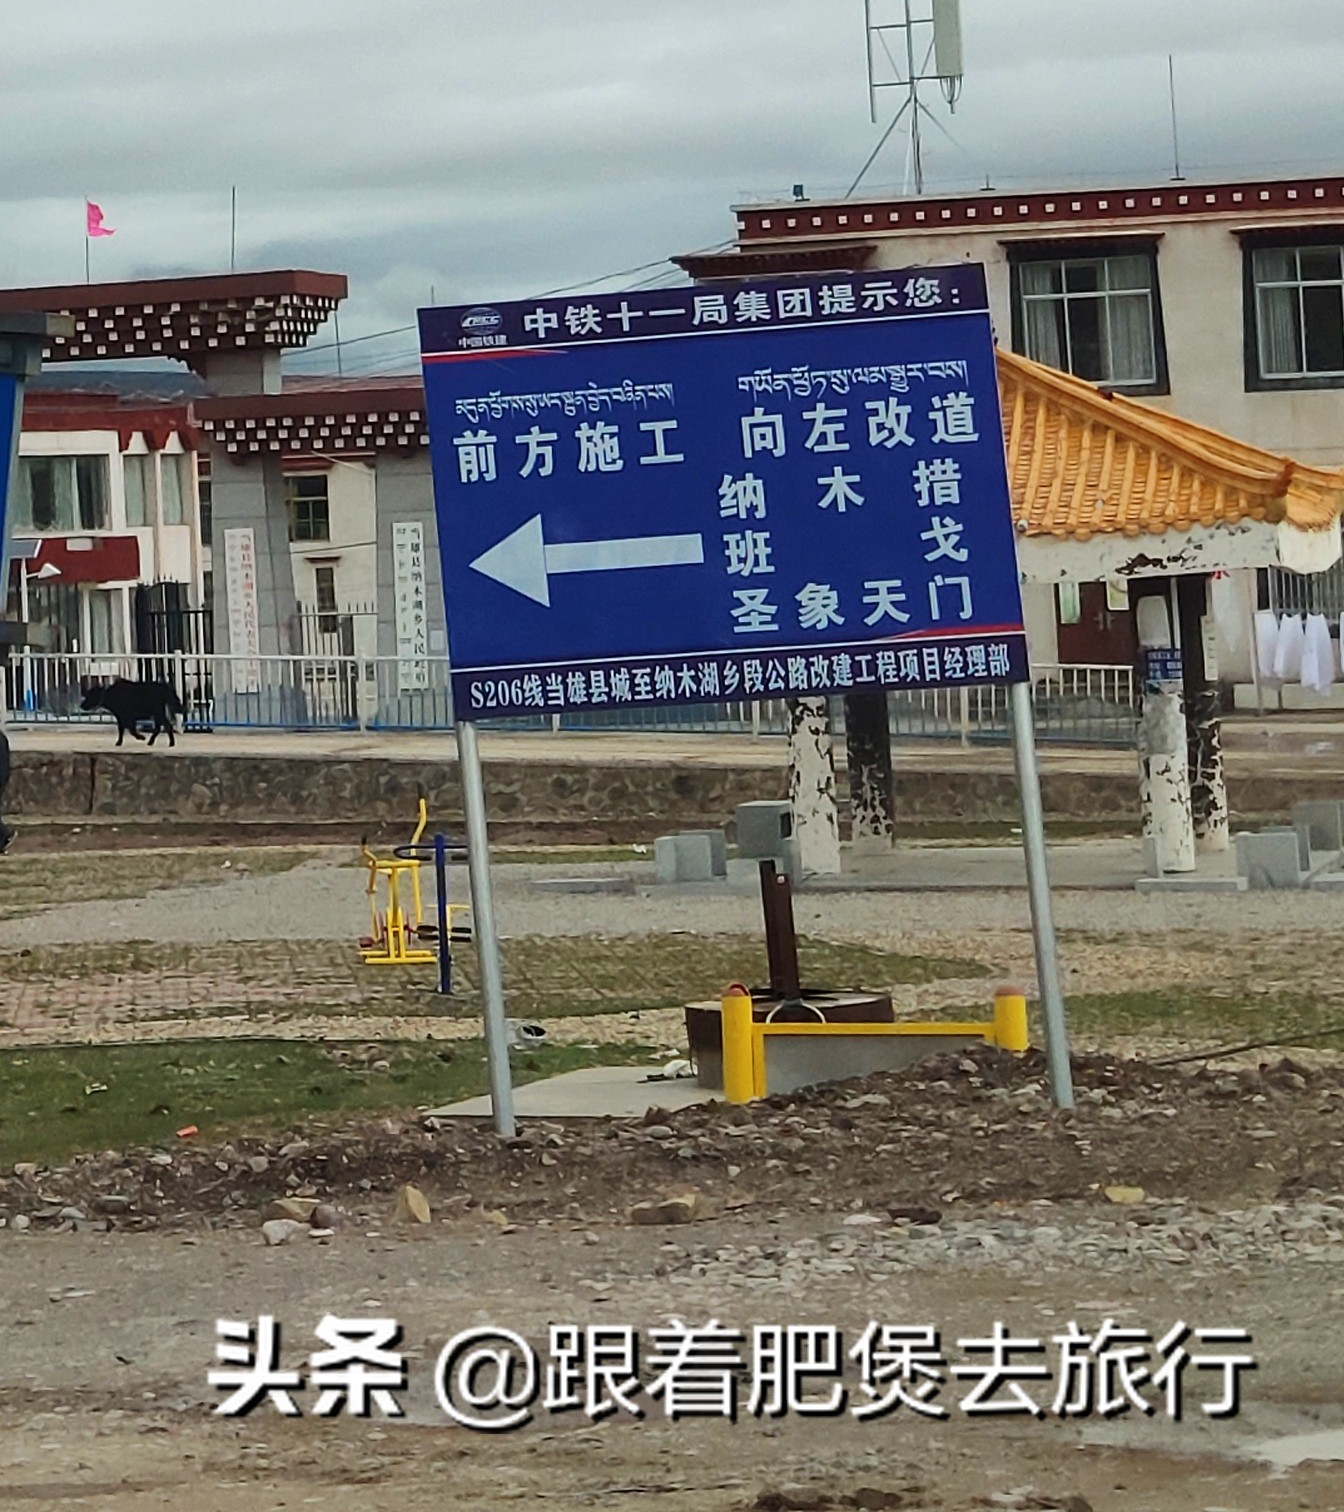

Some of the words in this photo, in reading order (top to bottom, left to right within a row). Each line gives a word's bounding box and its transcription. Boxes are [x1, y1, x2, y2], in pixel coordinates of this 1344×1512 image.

[453, 418, 686, 484] 前方施工
[740, 391, 980, 459] 向左改道
[718, 459, 963, 520] 纳木措
[730, 576, 975, 634] 圣象天门
